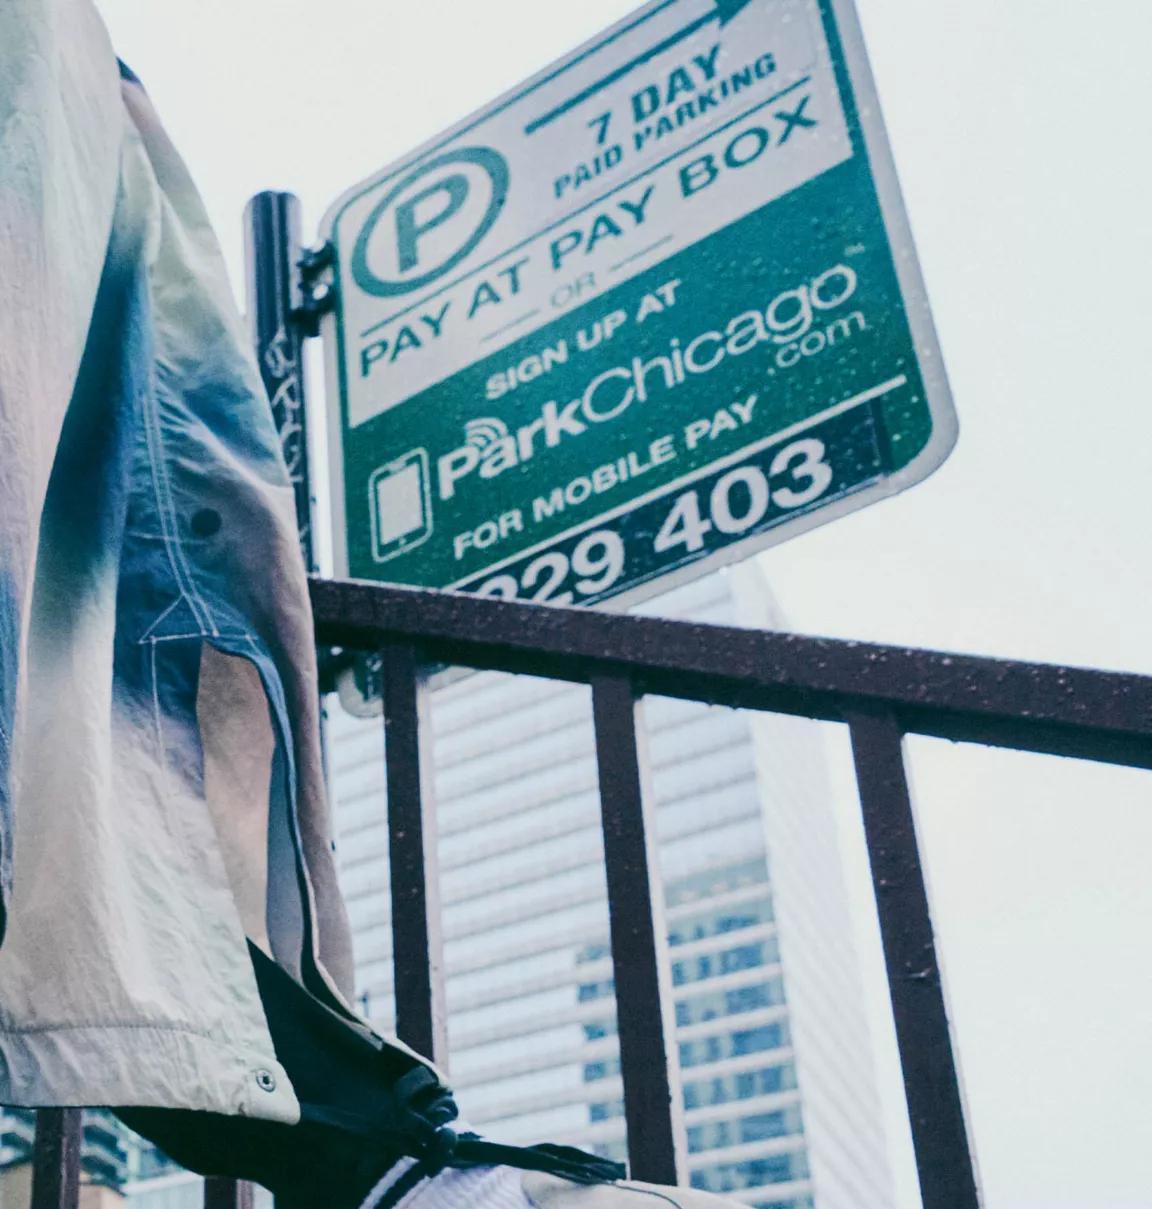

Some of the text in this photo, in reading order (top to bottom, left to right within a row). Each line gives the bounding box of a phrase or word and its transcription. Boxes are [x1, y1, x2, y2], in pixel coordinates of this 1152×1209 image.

[553, 52, 777, 199] PAID PARKING
[587, 42, 721, 145] 7 DAY
[360, 95, 818, 378] PAY AT PAY BOX
[394, 158, 469, 273] P
[485, 278, 682, 400] SIGN UP AT
[551, 272, 596, 308] OR
[438, 263, 857, 500] ParkChicago
[453, 394, 758, 560] FOR MOBILE PAY
[654, 438, 833, 553] 403
